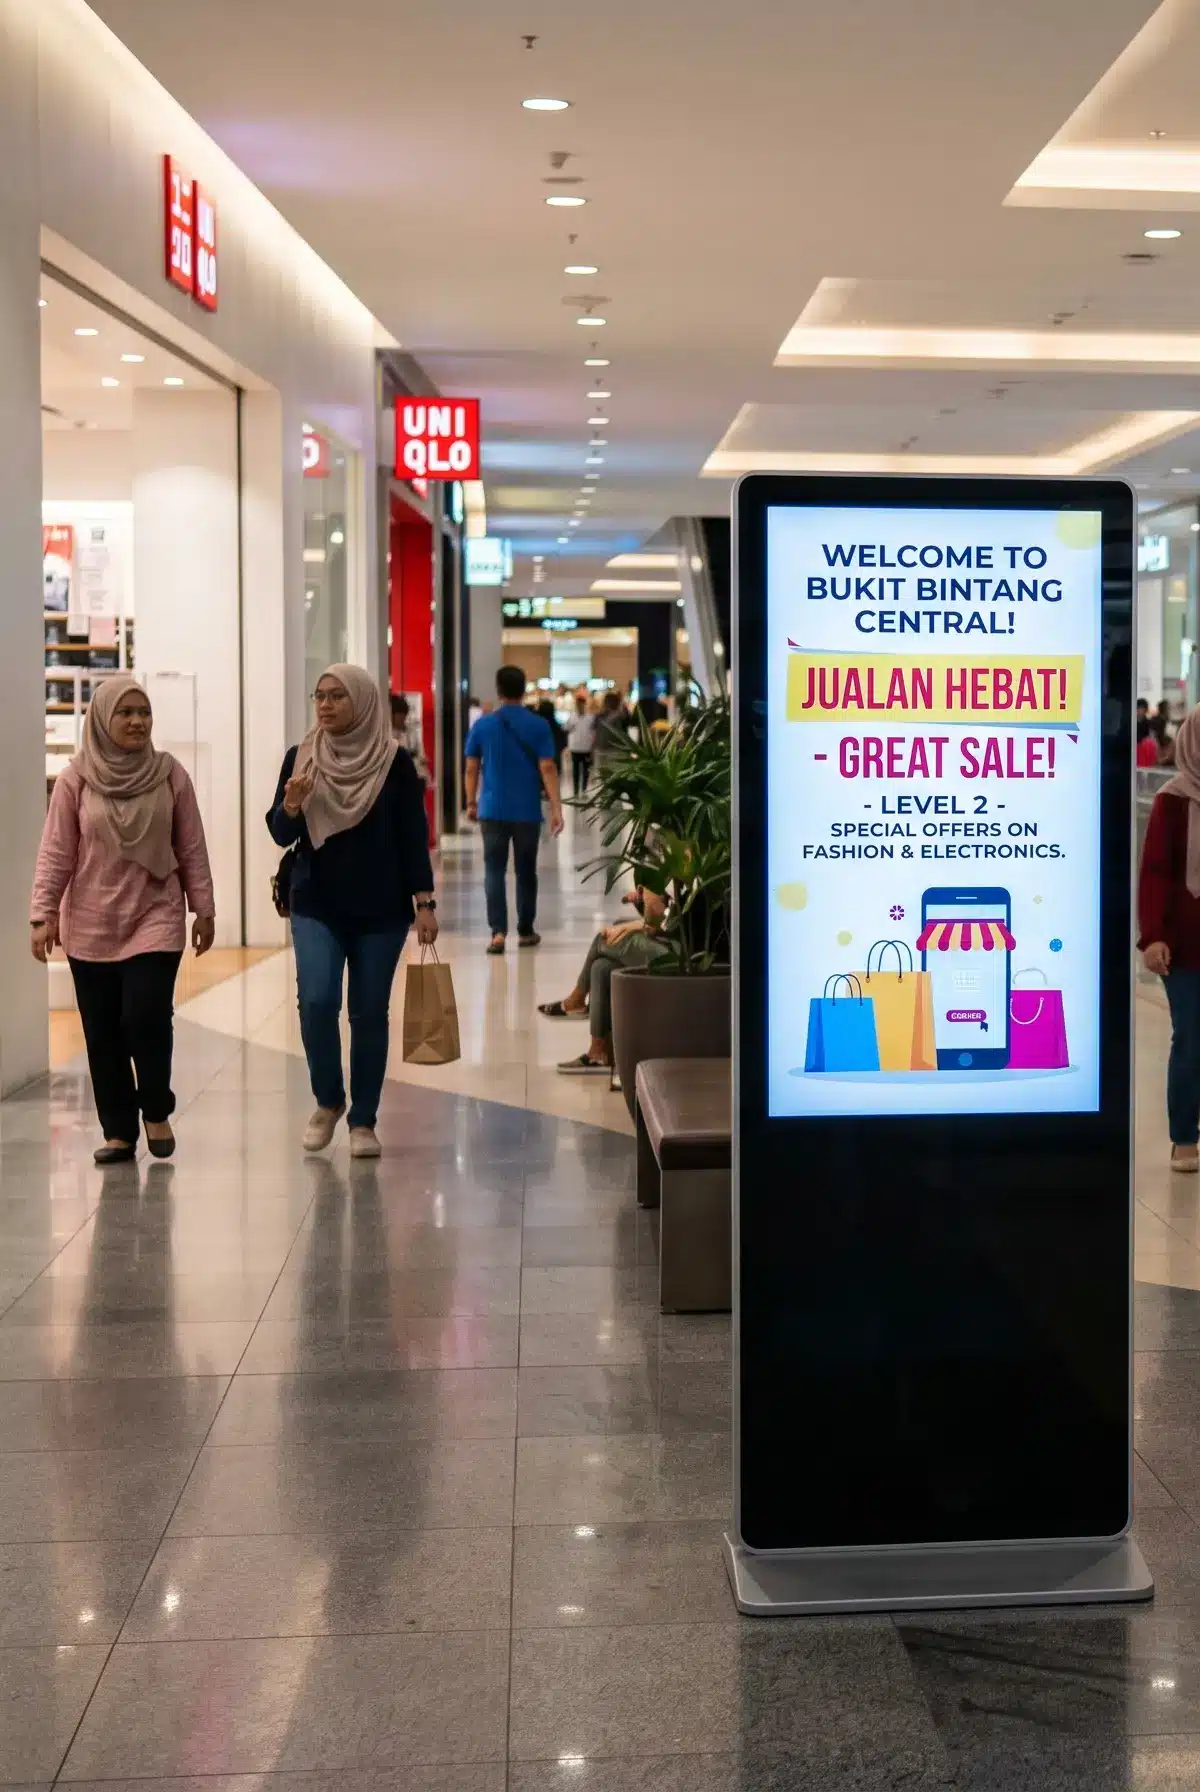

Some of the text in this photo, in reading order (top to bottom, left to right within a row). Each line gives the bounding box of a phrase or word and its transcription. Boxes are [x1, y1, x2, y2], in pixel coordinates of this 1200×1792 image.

[402, 404, 467, 438] UNI
[402, 439, 473, 477] QLO
[821, 543, 1047, 570] WELCOME TO
[807, 576, 1063, 603] BUKIT BINTANG
[854, 609, 1015, 635] CENTRAL!
[801, 666, 1067, 710] JUALAN HEBAT!
[839, 736, 950, 779] GREAT
[959, 736, 1056, 779] SALE!
[881, 795, 966, 815] LEVEL
[973, 795, 988, 815] 2
[830, 822, 1038, 838] SPECIAL OFFERS ON
[803, 844, 1066, 859] FASHION & ELECTRONICS.
